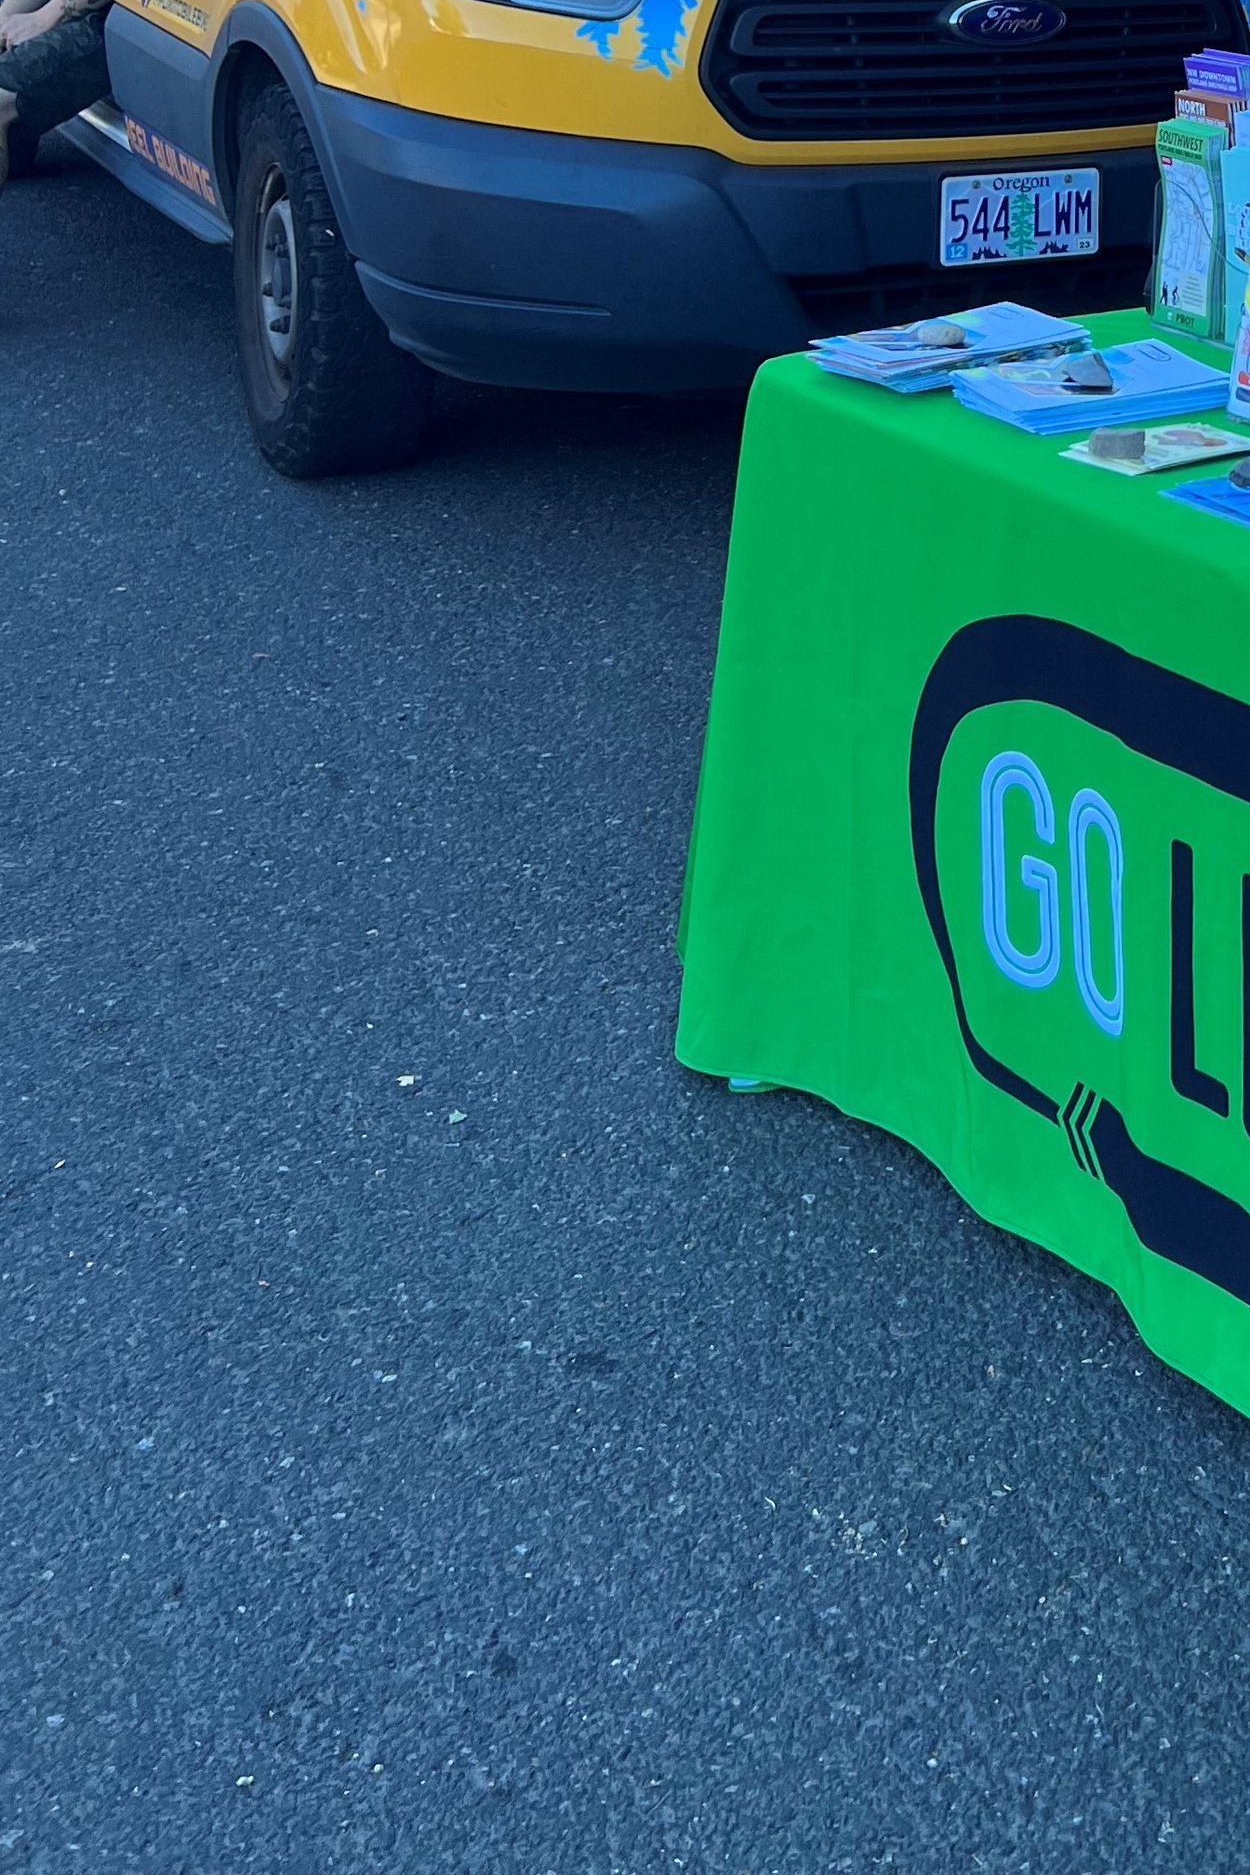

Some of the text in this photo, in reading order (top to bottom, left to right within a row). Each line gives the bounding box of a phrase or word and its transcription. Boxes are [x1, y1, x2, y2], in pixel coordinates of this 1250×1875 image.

[981, 5, 1043, 33] Ford
[1178, 98, 1206, 116] NORTH
[1159, 129, 1204, 152] SOUTHWEST
[151, 135, 217, 208] BUILDING
[993, 176, 1050, 192] Oregon
[951, 189, 1092, 243] 544 LWM
[950, 247, 965, 258] 12
[1079, 241, 1091, 249] 23
[1176, 313, 1196, 326] PBOT
[981, 751, 1124, 1036] GO
